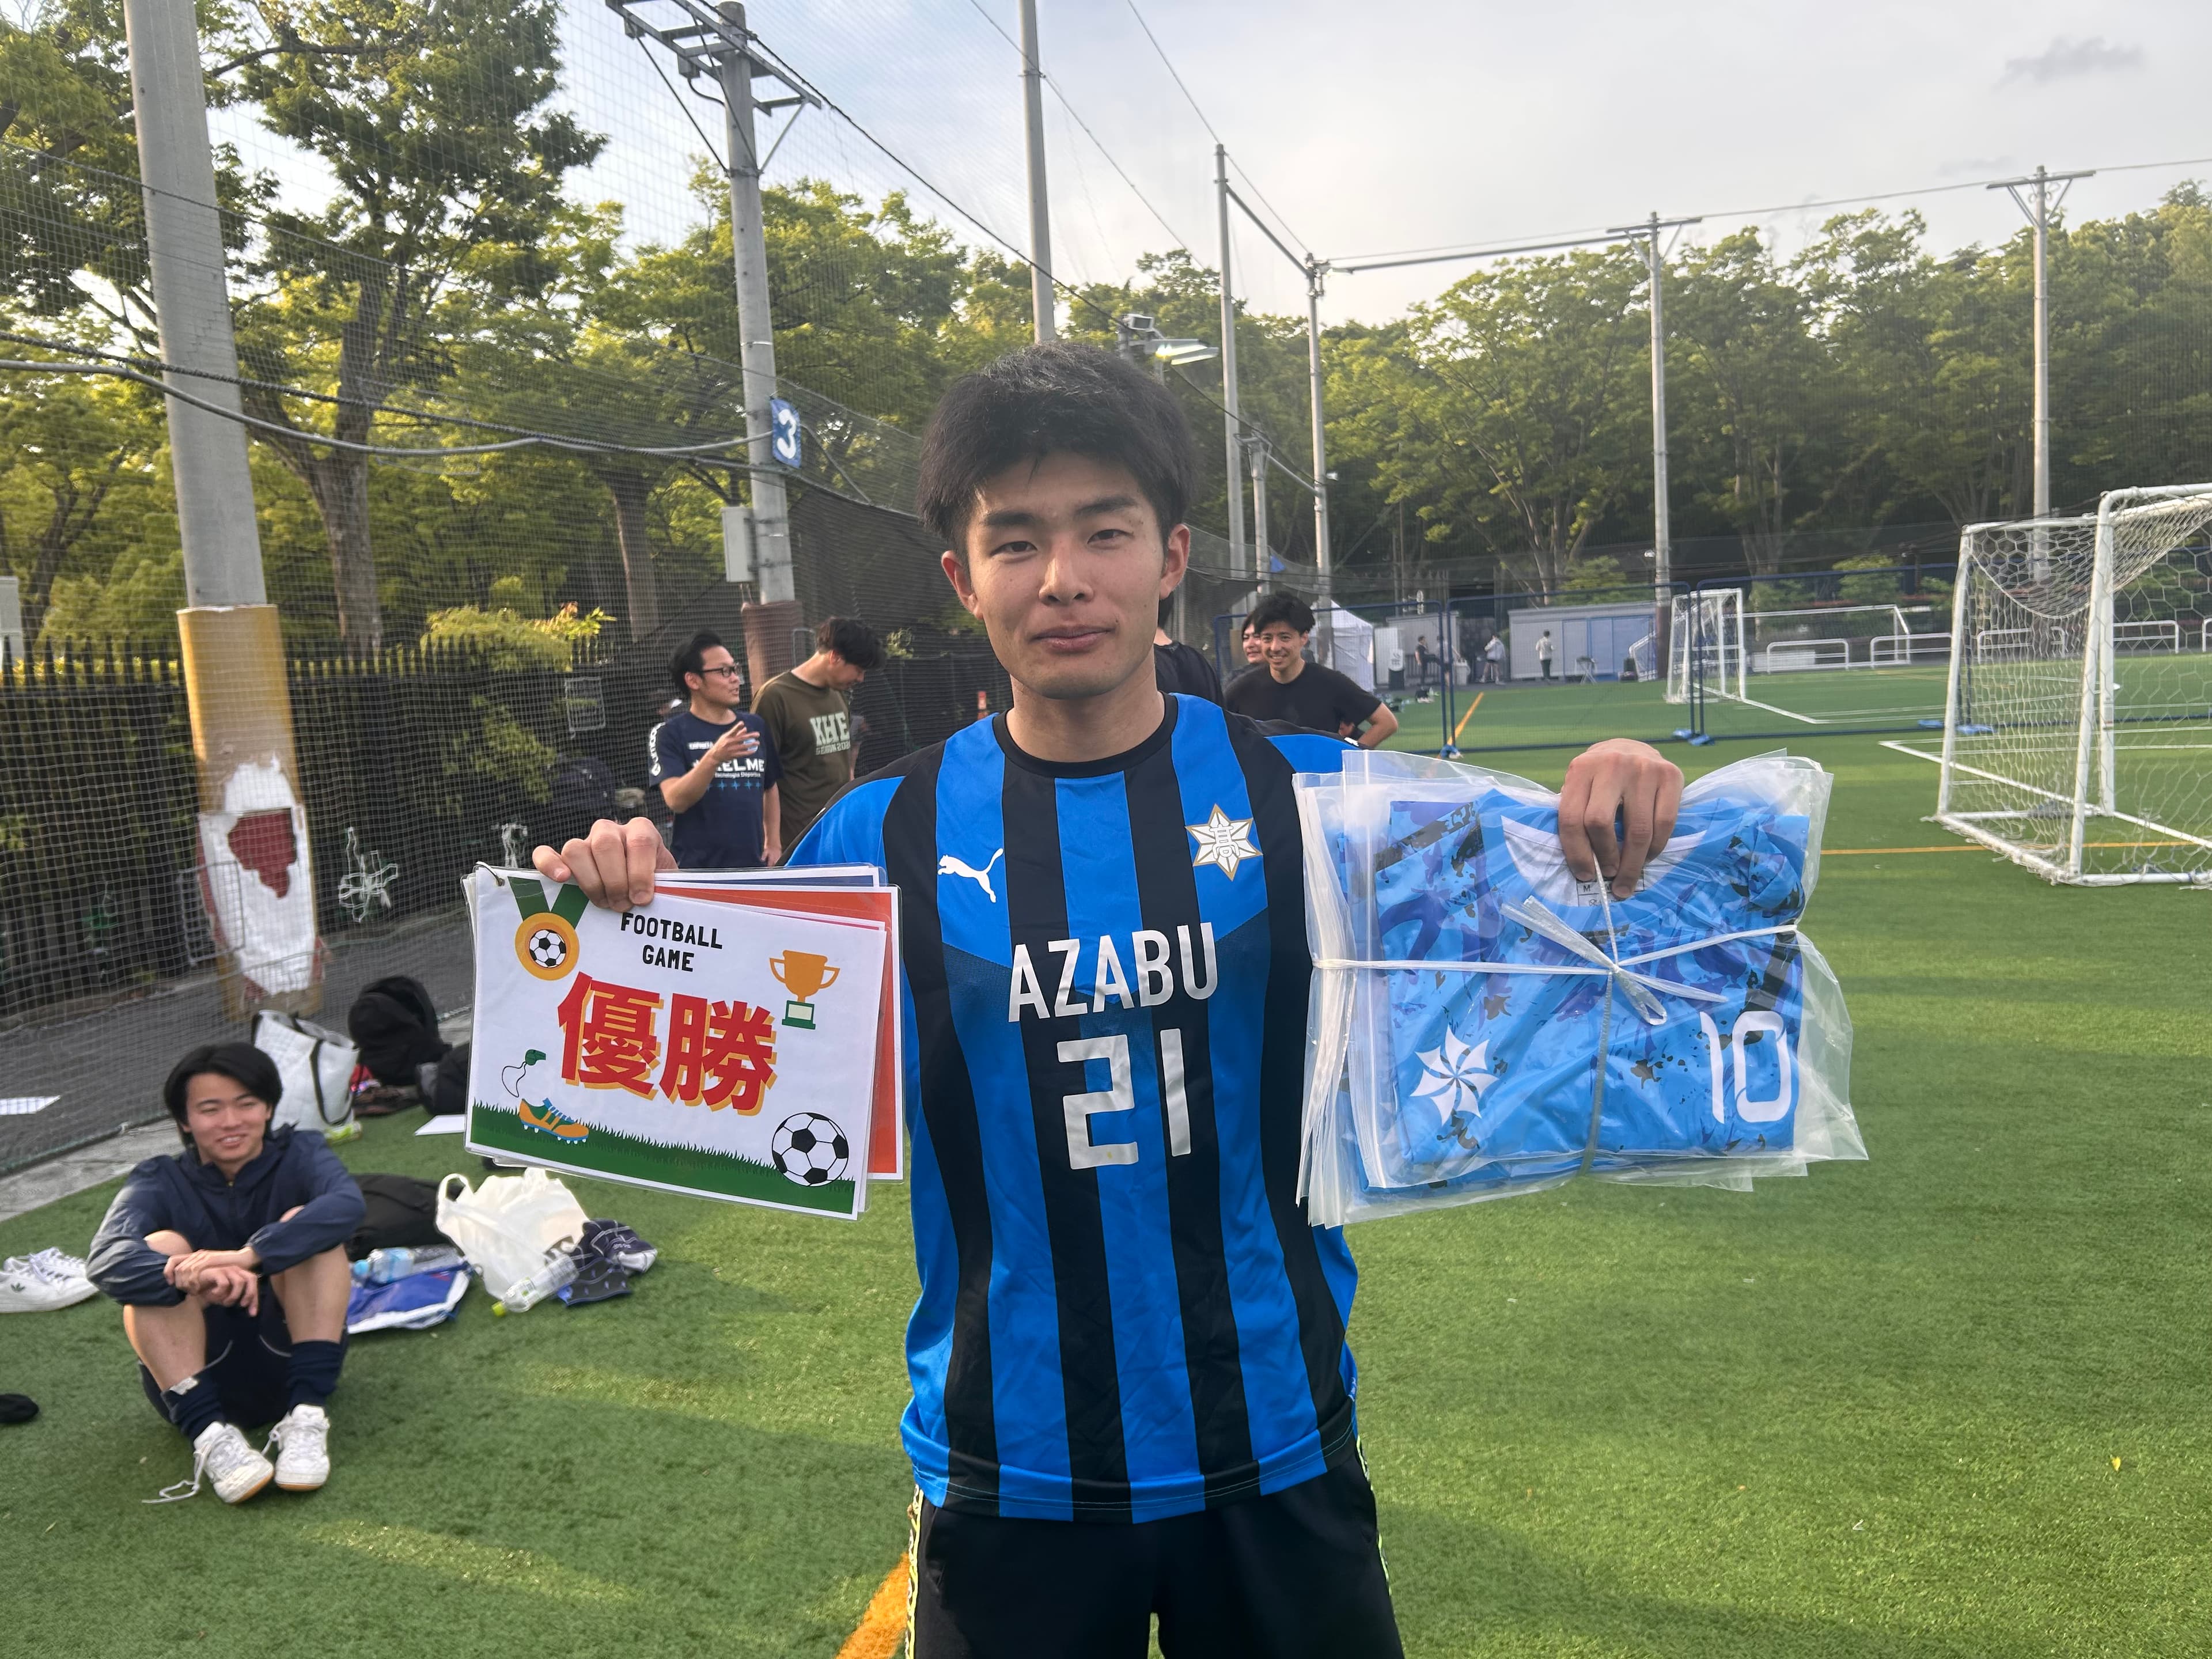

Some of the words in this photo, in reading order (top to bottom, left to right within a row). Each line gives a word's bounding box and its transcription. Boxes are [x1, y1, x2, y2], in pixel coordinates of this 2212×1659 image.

[776, 408, 797, 459] 3
[716, 757, 765, 772] ELME
[620, 912, 723, 950] FOOTBALL
[642, 945, 695, 972] GAME
[1007, 922, 1219, 1022] AZABU
[557, 971, 778, 1116] 優勝
[1698, 1010, 1791, 1124] 10
[1056, 1028, 1191, 1170] 21
